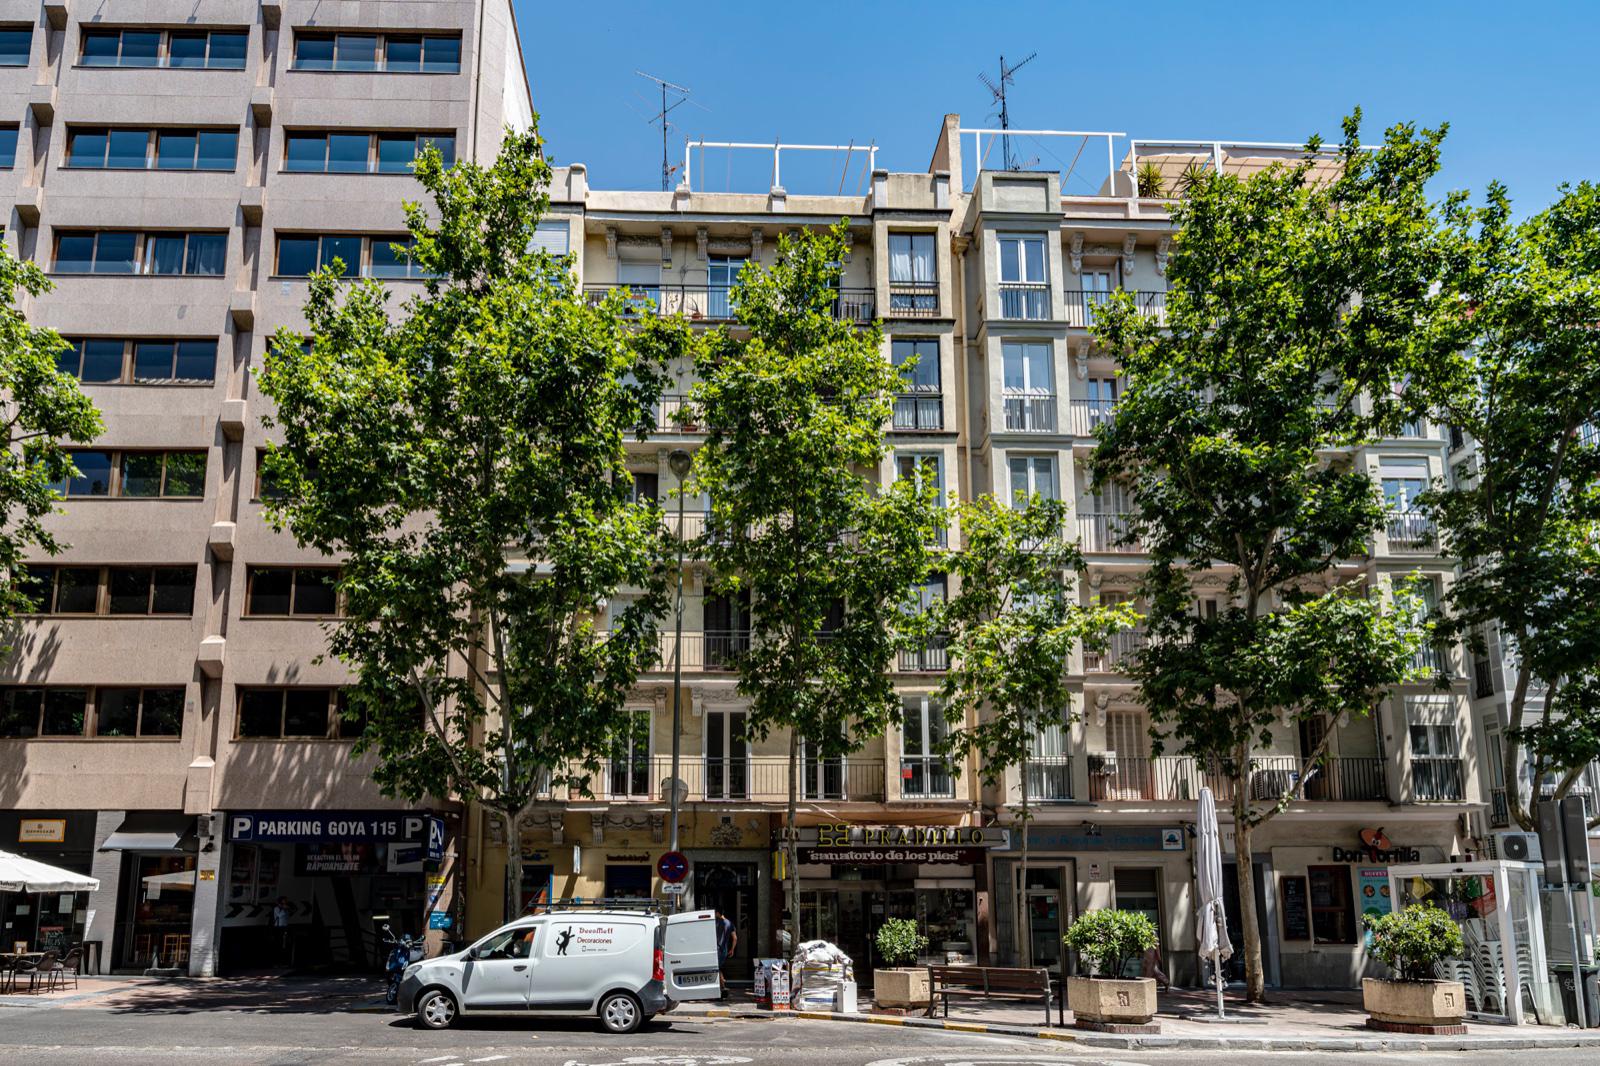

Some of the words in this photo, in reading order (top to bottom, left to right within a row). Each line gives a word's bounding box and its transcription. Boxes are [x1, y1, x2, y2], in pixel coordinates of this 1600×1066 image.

[232, 817, 251, 838] P
[258, 821, 322, 836] PARKING
[328, 821, 366, 836] GOYA
[370, 821, 397, 836] 115
[405, 817, 423, 838] P
[864, 829, 984, 845] PRADILLO
[885, 850, 903, 861] de
[904, 850, 926, 861] los
[1333, 846, 1362, 862] Don
